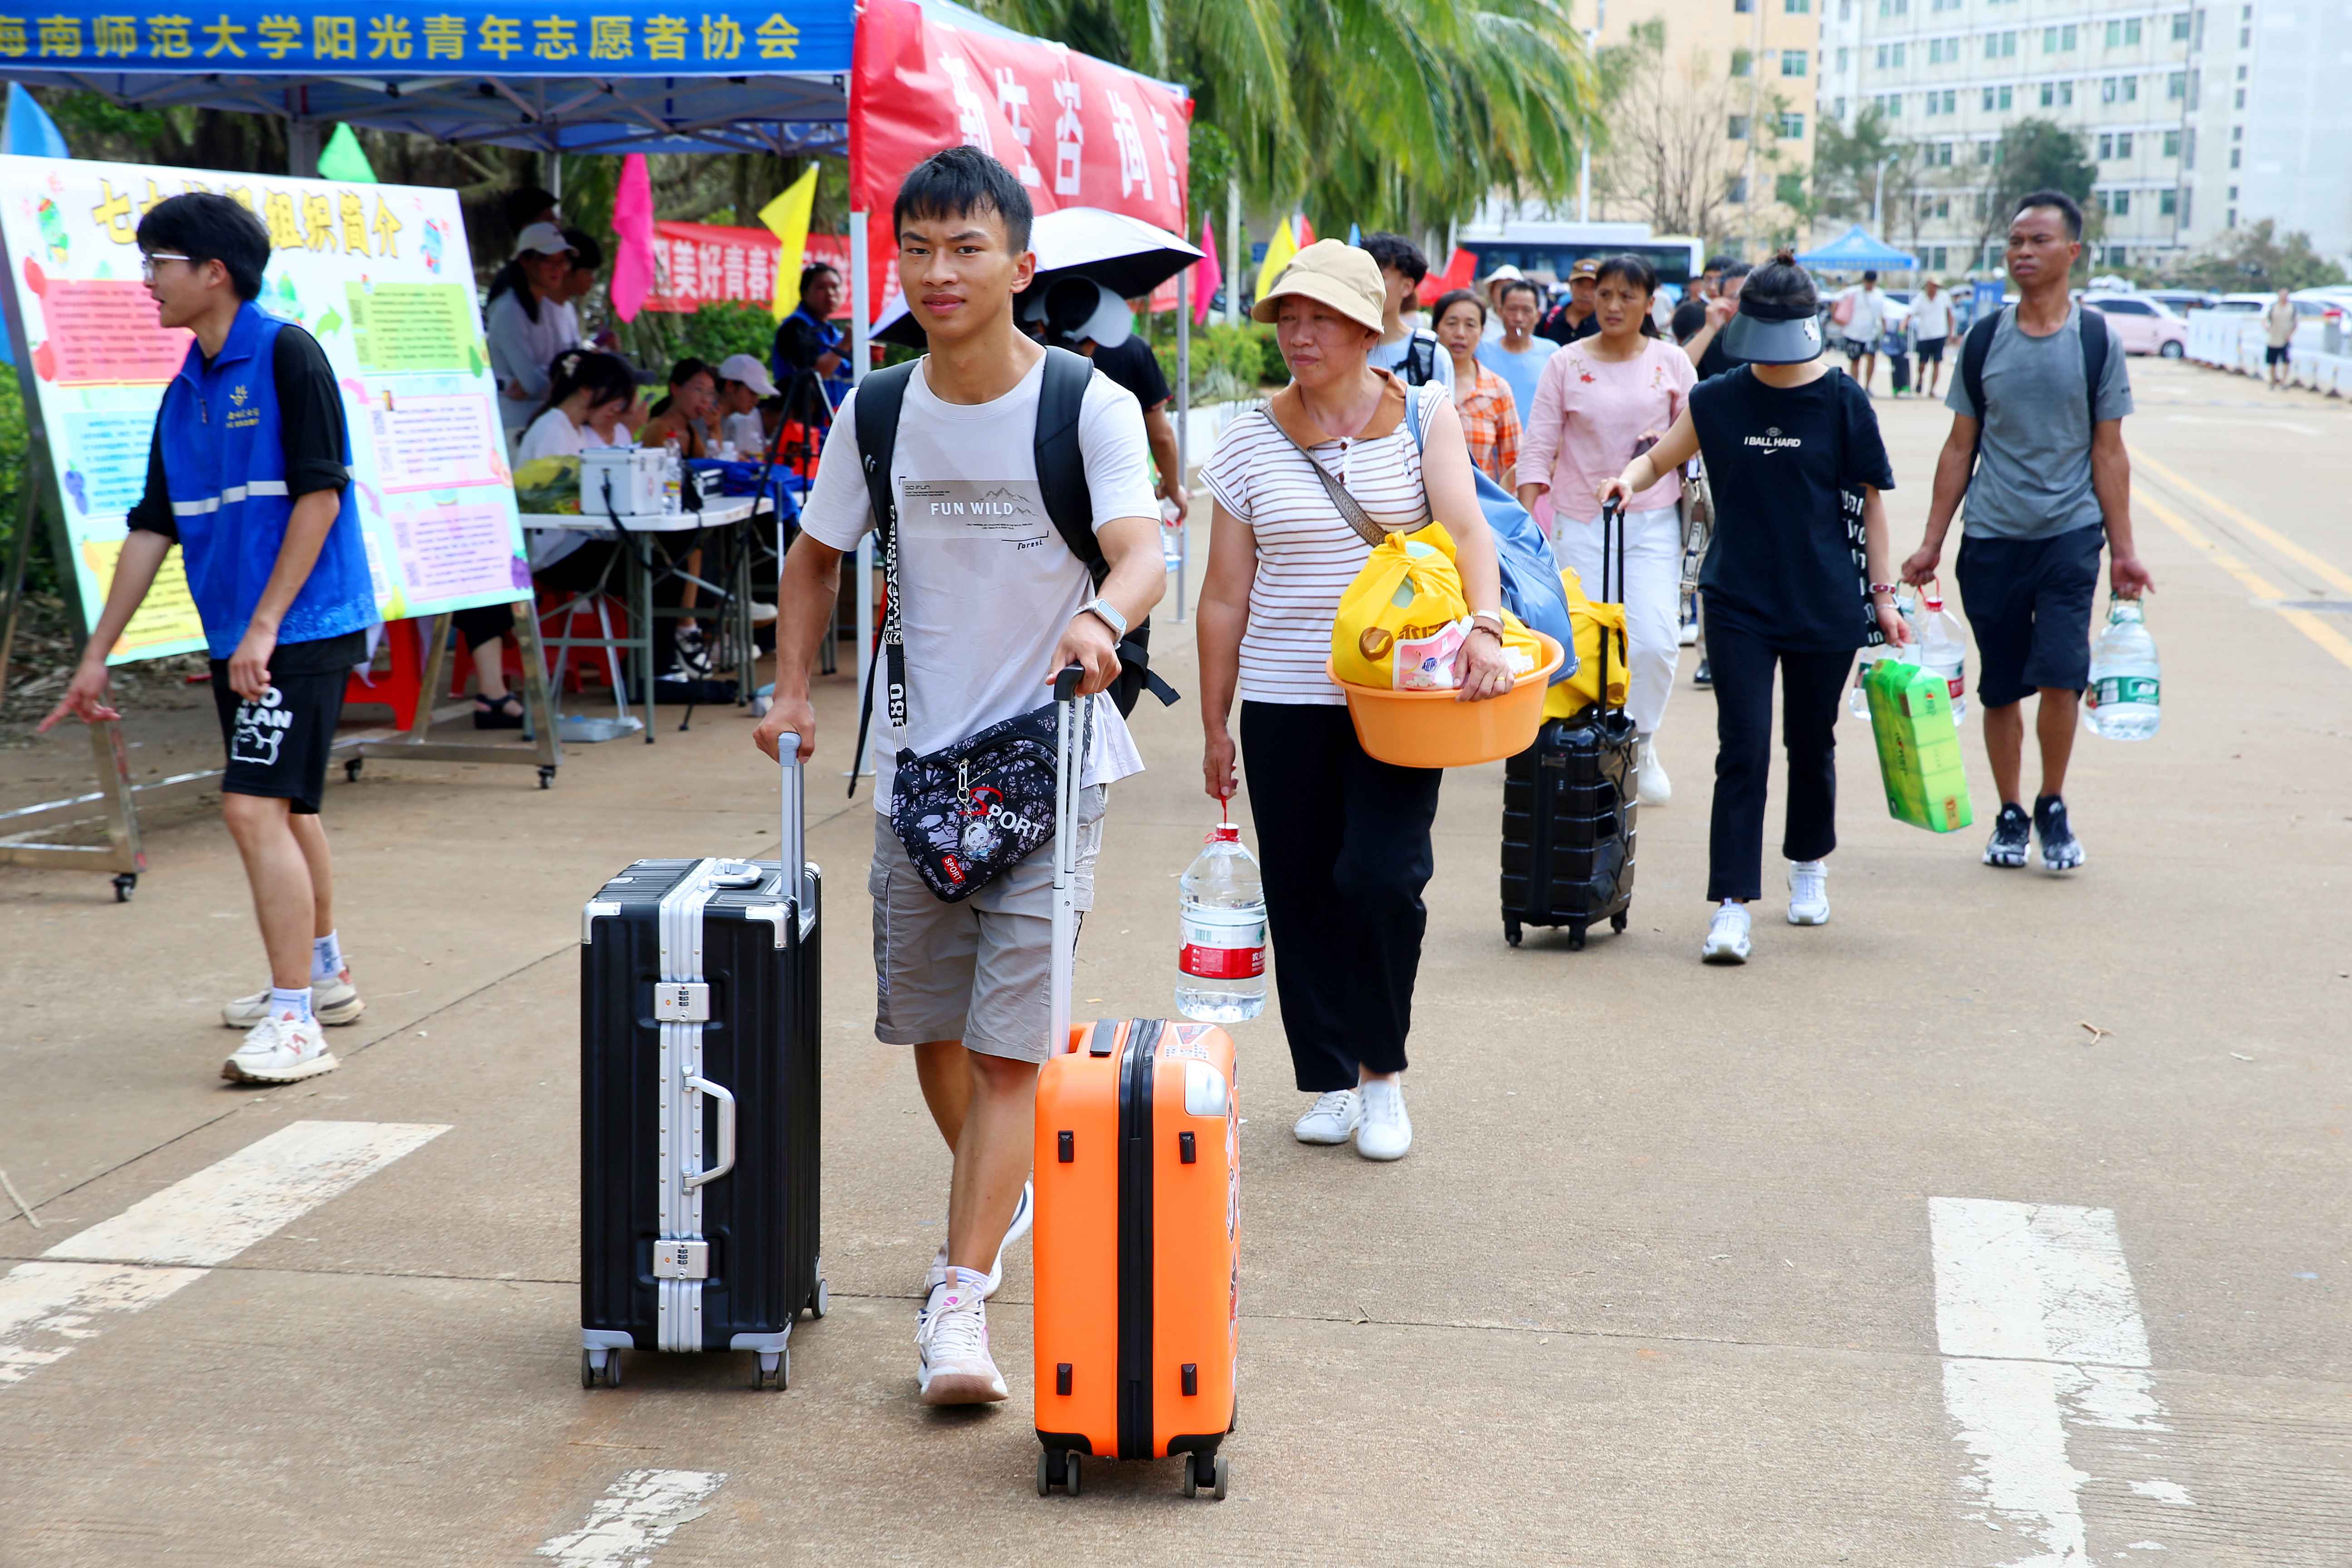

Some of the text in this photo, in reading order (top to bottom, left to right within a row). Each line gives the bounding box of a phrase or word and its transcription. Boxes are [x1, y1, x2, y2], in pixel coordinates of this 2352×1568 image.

[0, 14, 800, 61] 海南师范大学阳光青年志愿者协会
[1744, 436, 1801, 447] I BALL HARD
[930, 502, 1014, 516] FUN WILD
[957, 786, 1046, 841] SPORT
[945, 858, 963, 881] SPORT
